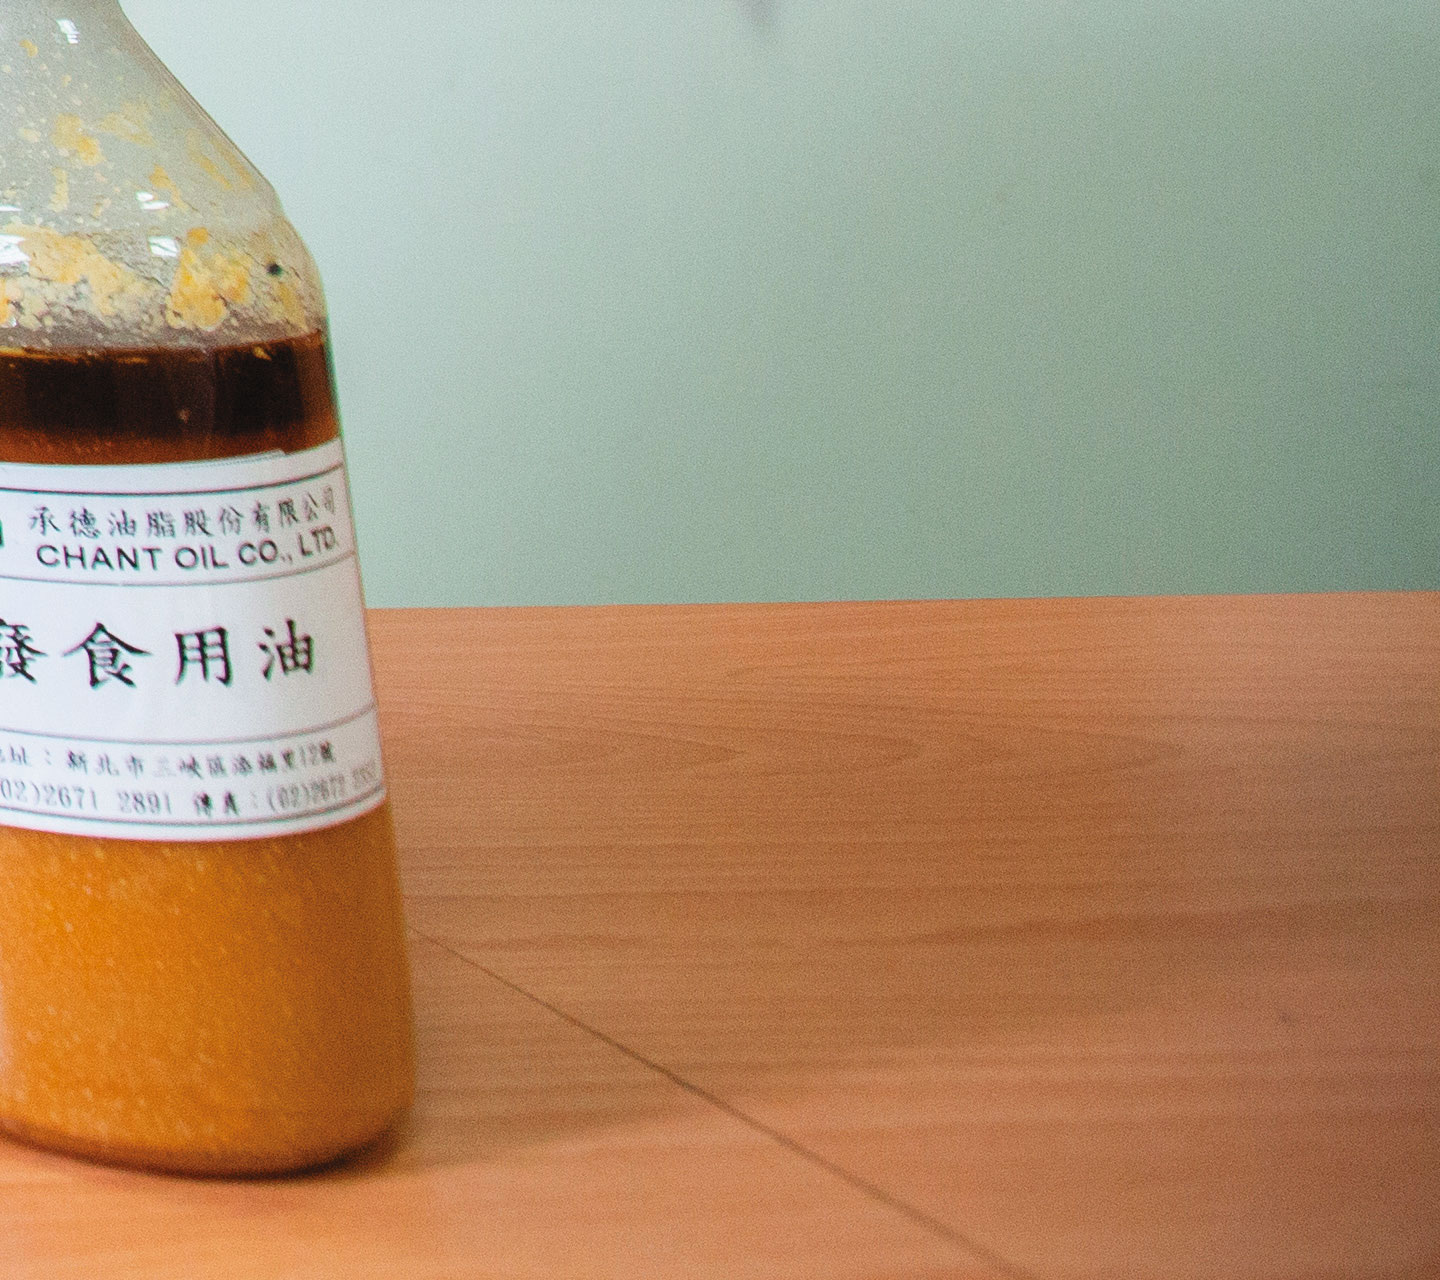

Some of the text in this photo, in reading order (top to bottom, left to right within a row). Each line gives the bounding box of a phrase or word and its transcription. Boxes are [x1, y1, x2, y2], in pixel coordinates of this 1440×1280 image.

[36, 543, 166, 572] CHANT
[174, 544, 229, 569] OIL
[237, 538, 295, 564] CO.,
